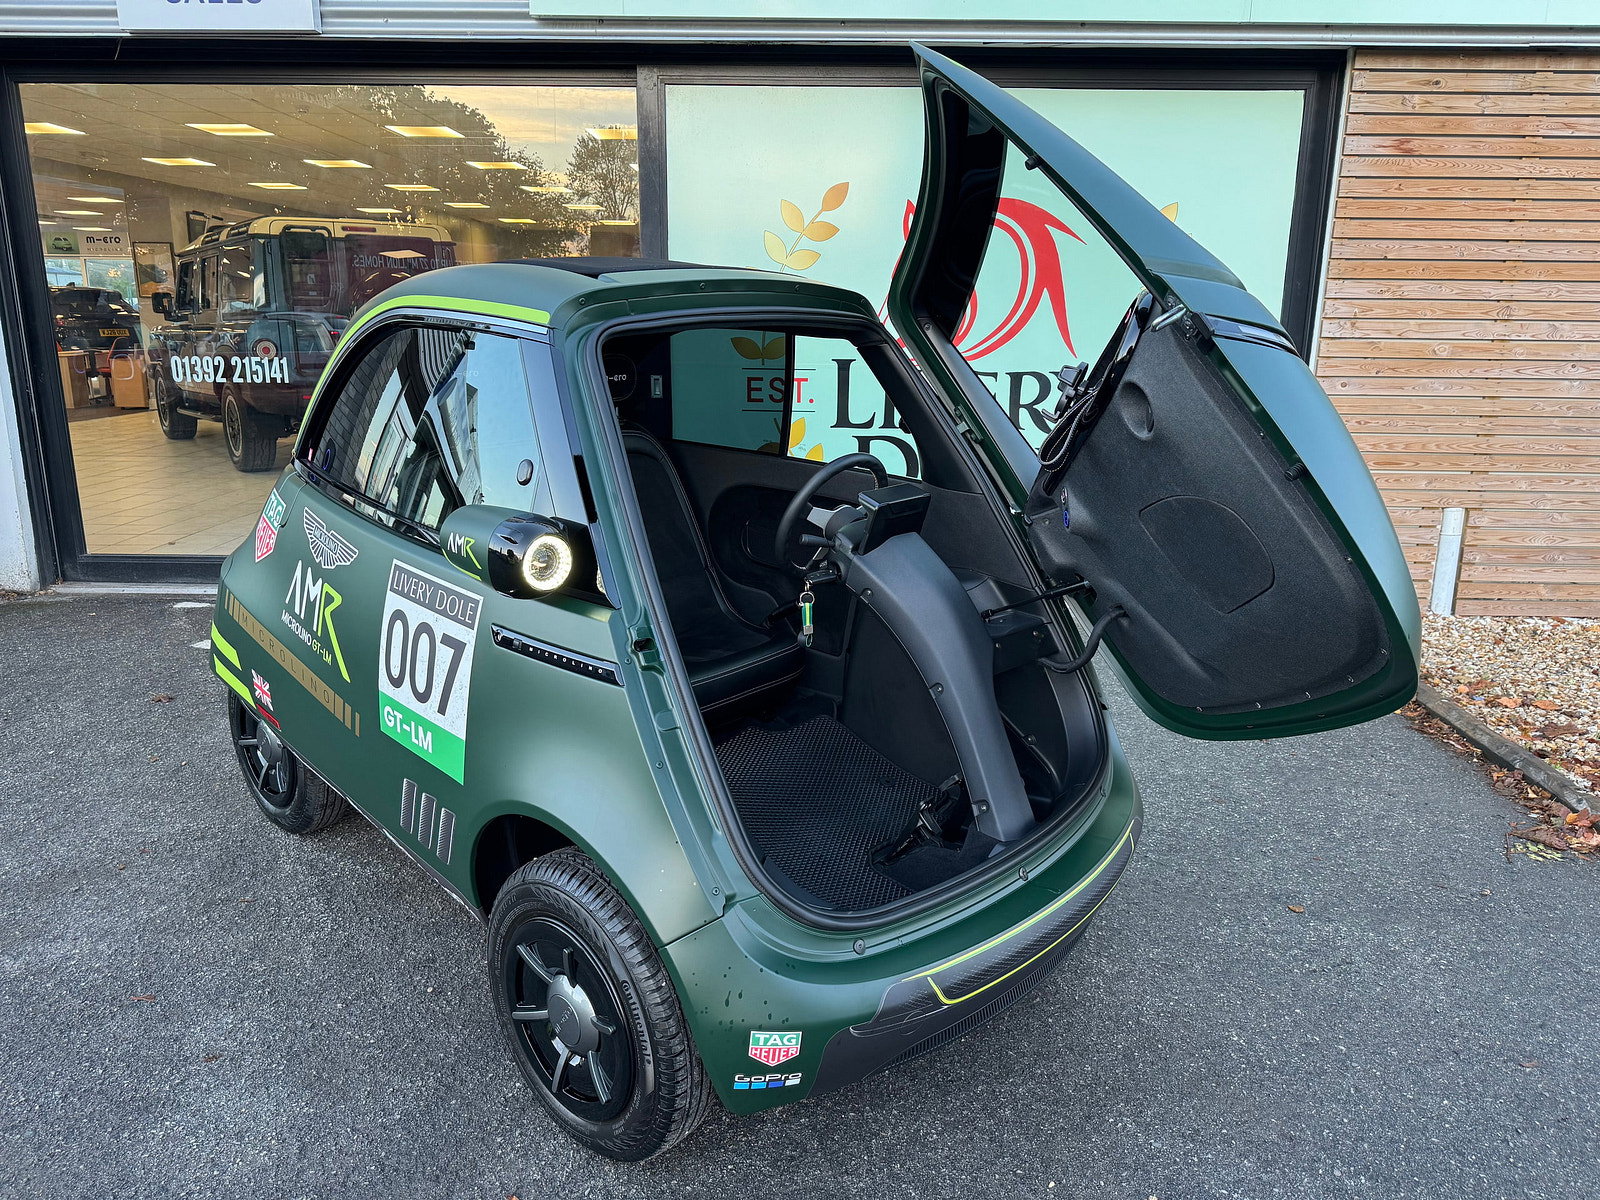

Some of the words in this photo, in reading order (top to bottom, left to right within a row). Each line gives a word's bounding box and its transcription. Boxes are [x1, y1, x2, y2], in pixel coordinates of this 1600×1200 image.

[171, 355, 227, 383] 01392
[230, 356, 289, 384] 215141
[746, 376, 815, 404] EST.
[265, 491, 283, 527] TAG
[447, 531, 482, 570] AMR
[393, 570, 434, 604] LIVERY
[435, 589, 475, 624] DOLE
[281, 609, 312, 646] MICROLINO
[312, 639, 332, 666] GT-LM
[285, 559, 351, 684] AMR
[240, 611, 331, 704] MICROLINO
[384, 608, 468, 717] 007
[529, 646, 604, 674] MICROLINO
[383, 705, 433, 754] GT-LM
[620, 979, 651, 1060] Continental
[751, 1047, 797, 1064] HEUER
[754, 1034, 797, 1046] TAG
[734, 1072, 803, 1082] GoPro
